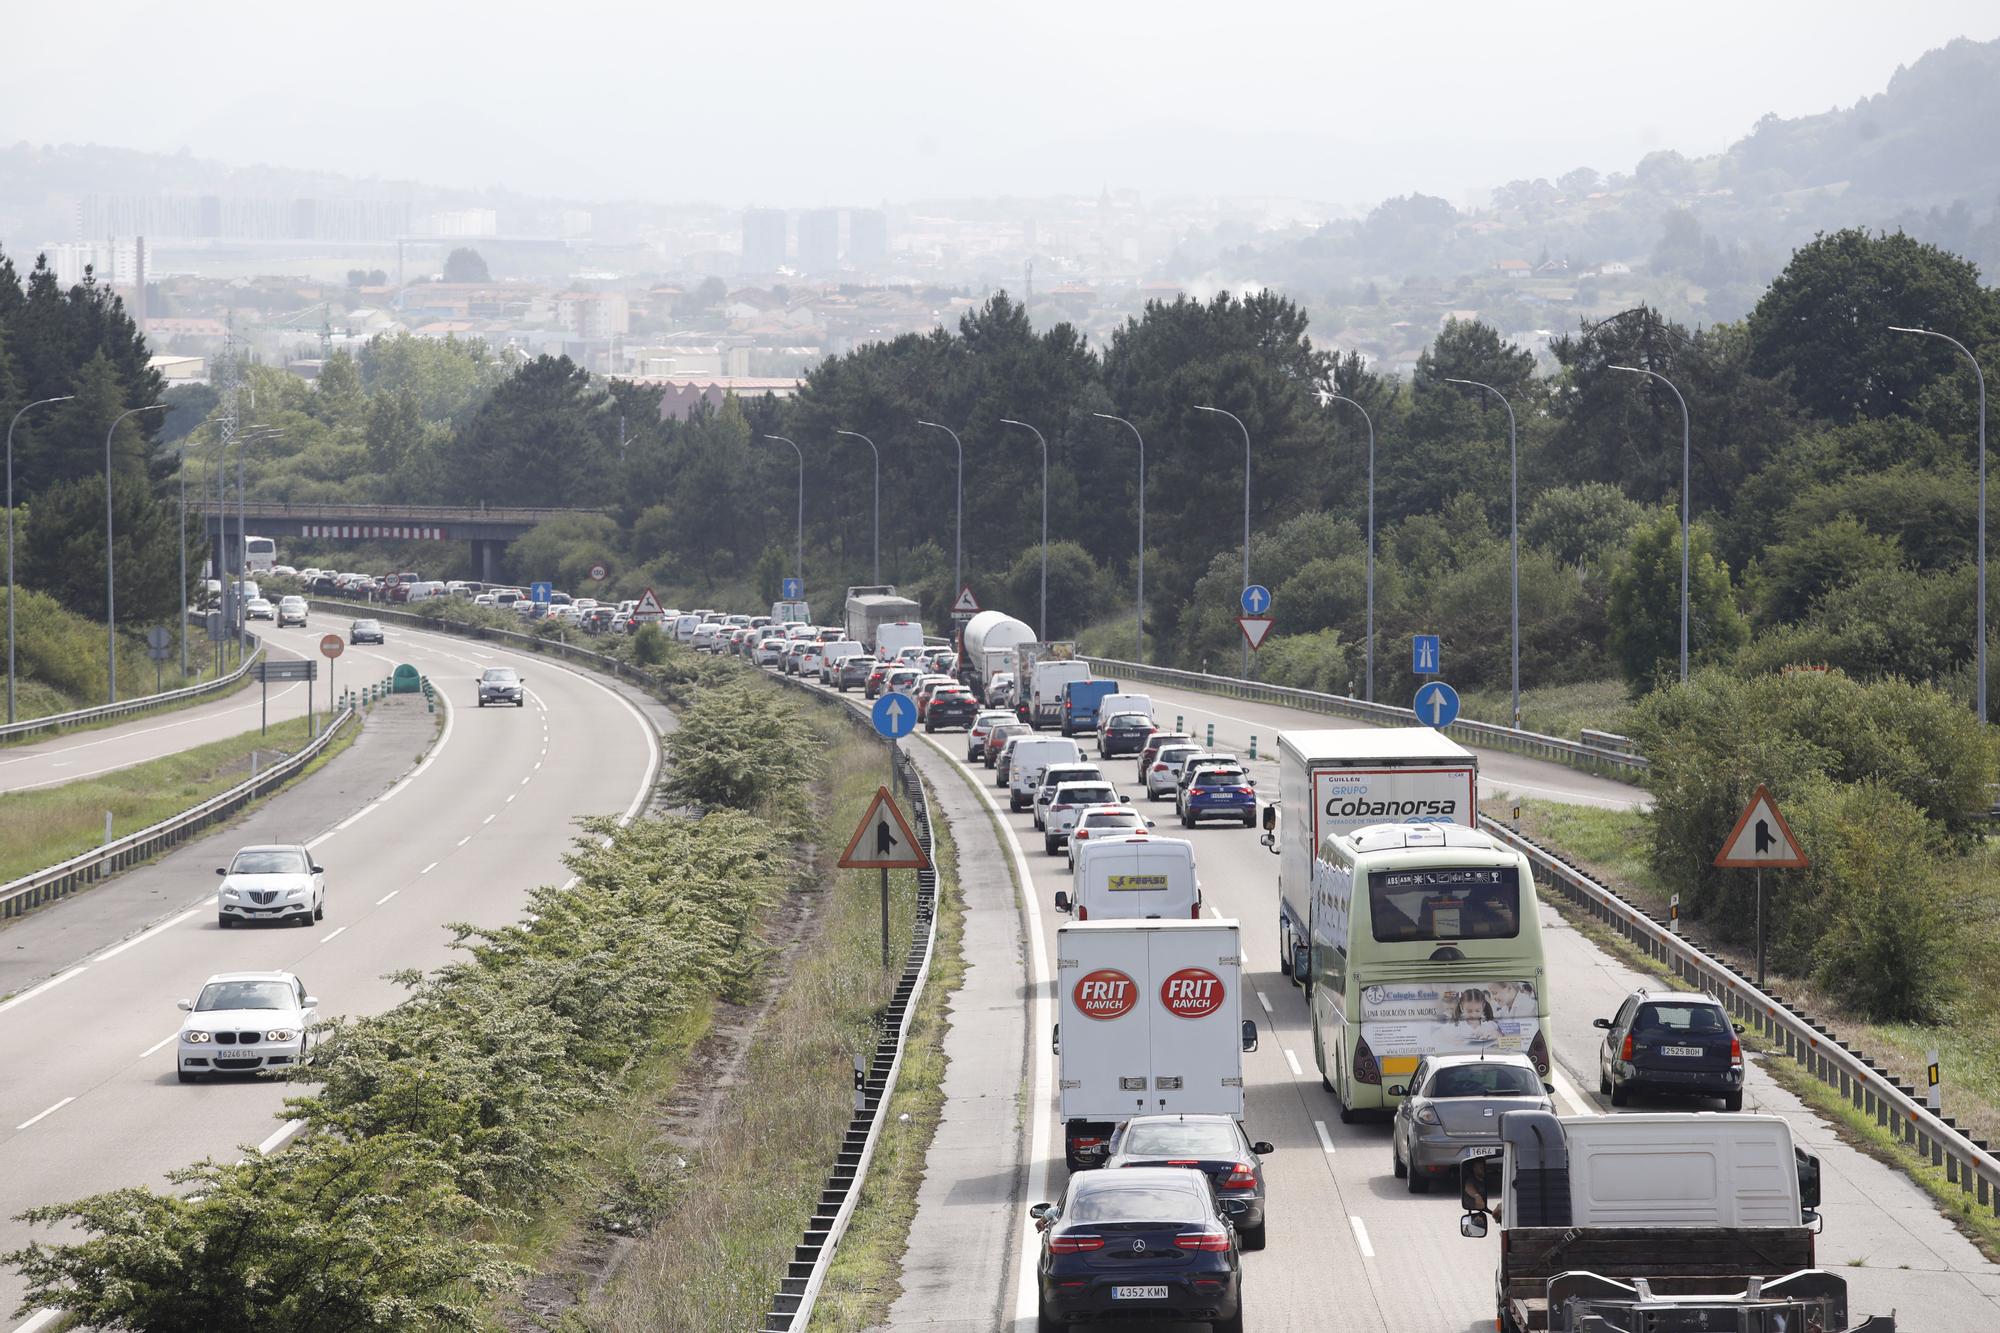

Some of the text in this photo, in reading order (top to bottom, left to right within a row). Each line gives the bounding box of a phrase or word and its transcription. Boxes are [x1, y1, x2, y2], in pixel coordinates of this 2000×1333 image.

[1331, 786, 1368, 796] GRUPO
[1326, 797, 1456, 817] Cobanorsa
[1081, 980, 1130, 1000] FRIT
[1168, 979, 1218, 999] FRIT
[1085, 1000, 1124, 1009] RAVICH
[1172, 999, 1211, 1009] RAVICH
[1367, 1009, 1378, 1017] UNA
[1408, 1008, 1415, 1016] EN
[1417, 1008, 1437, 1016] VALORES
[1665, 1047, 1684, 1055] 2525
[1119, 1287, 1167, 1298] 4352 KMN
